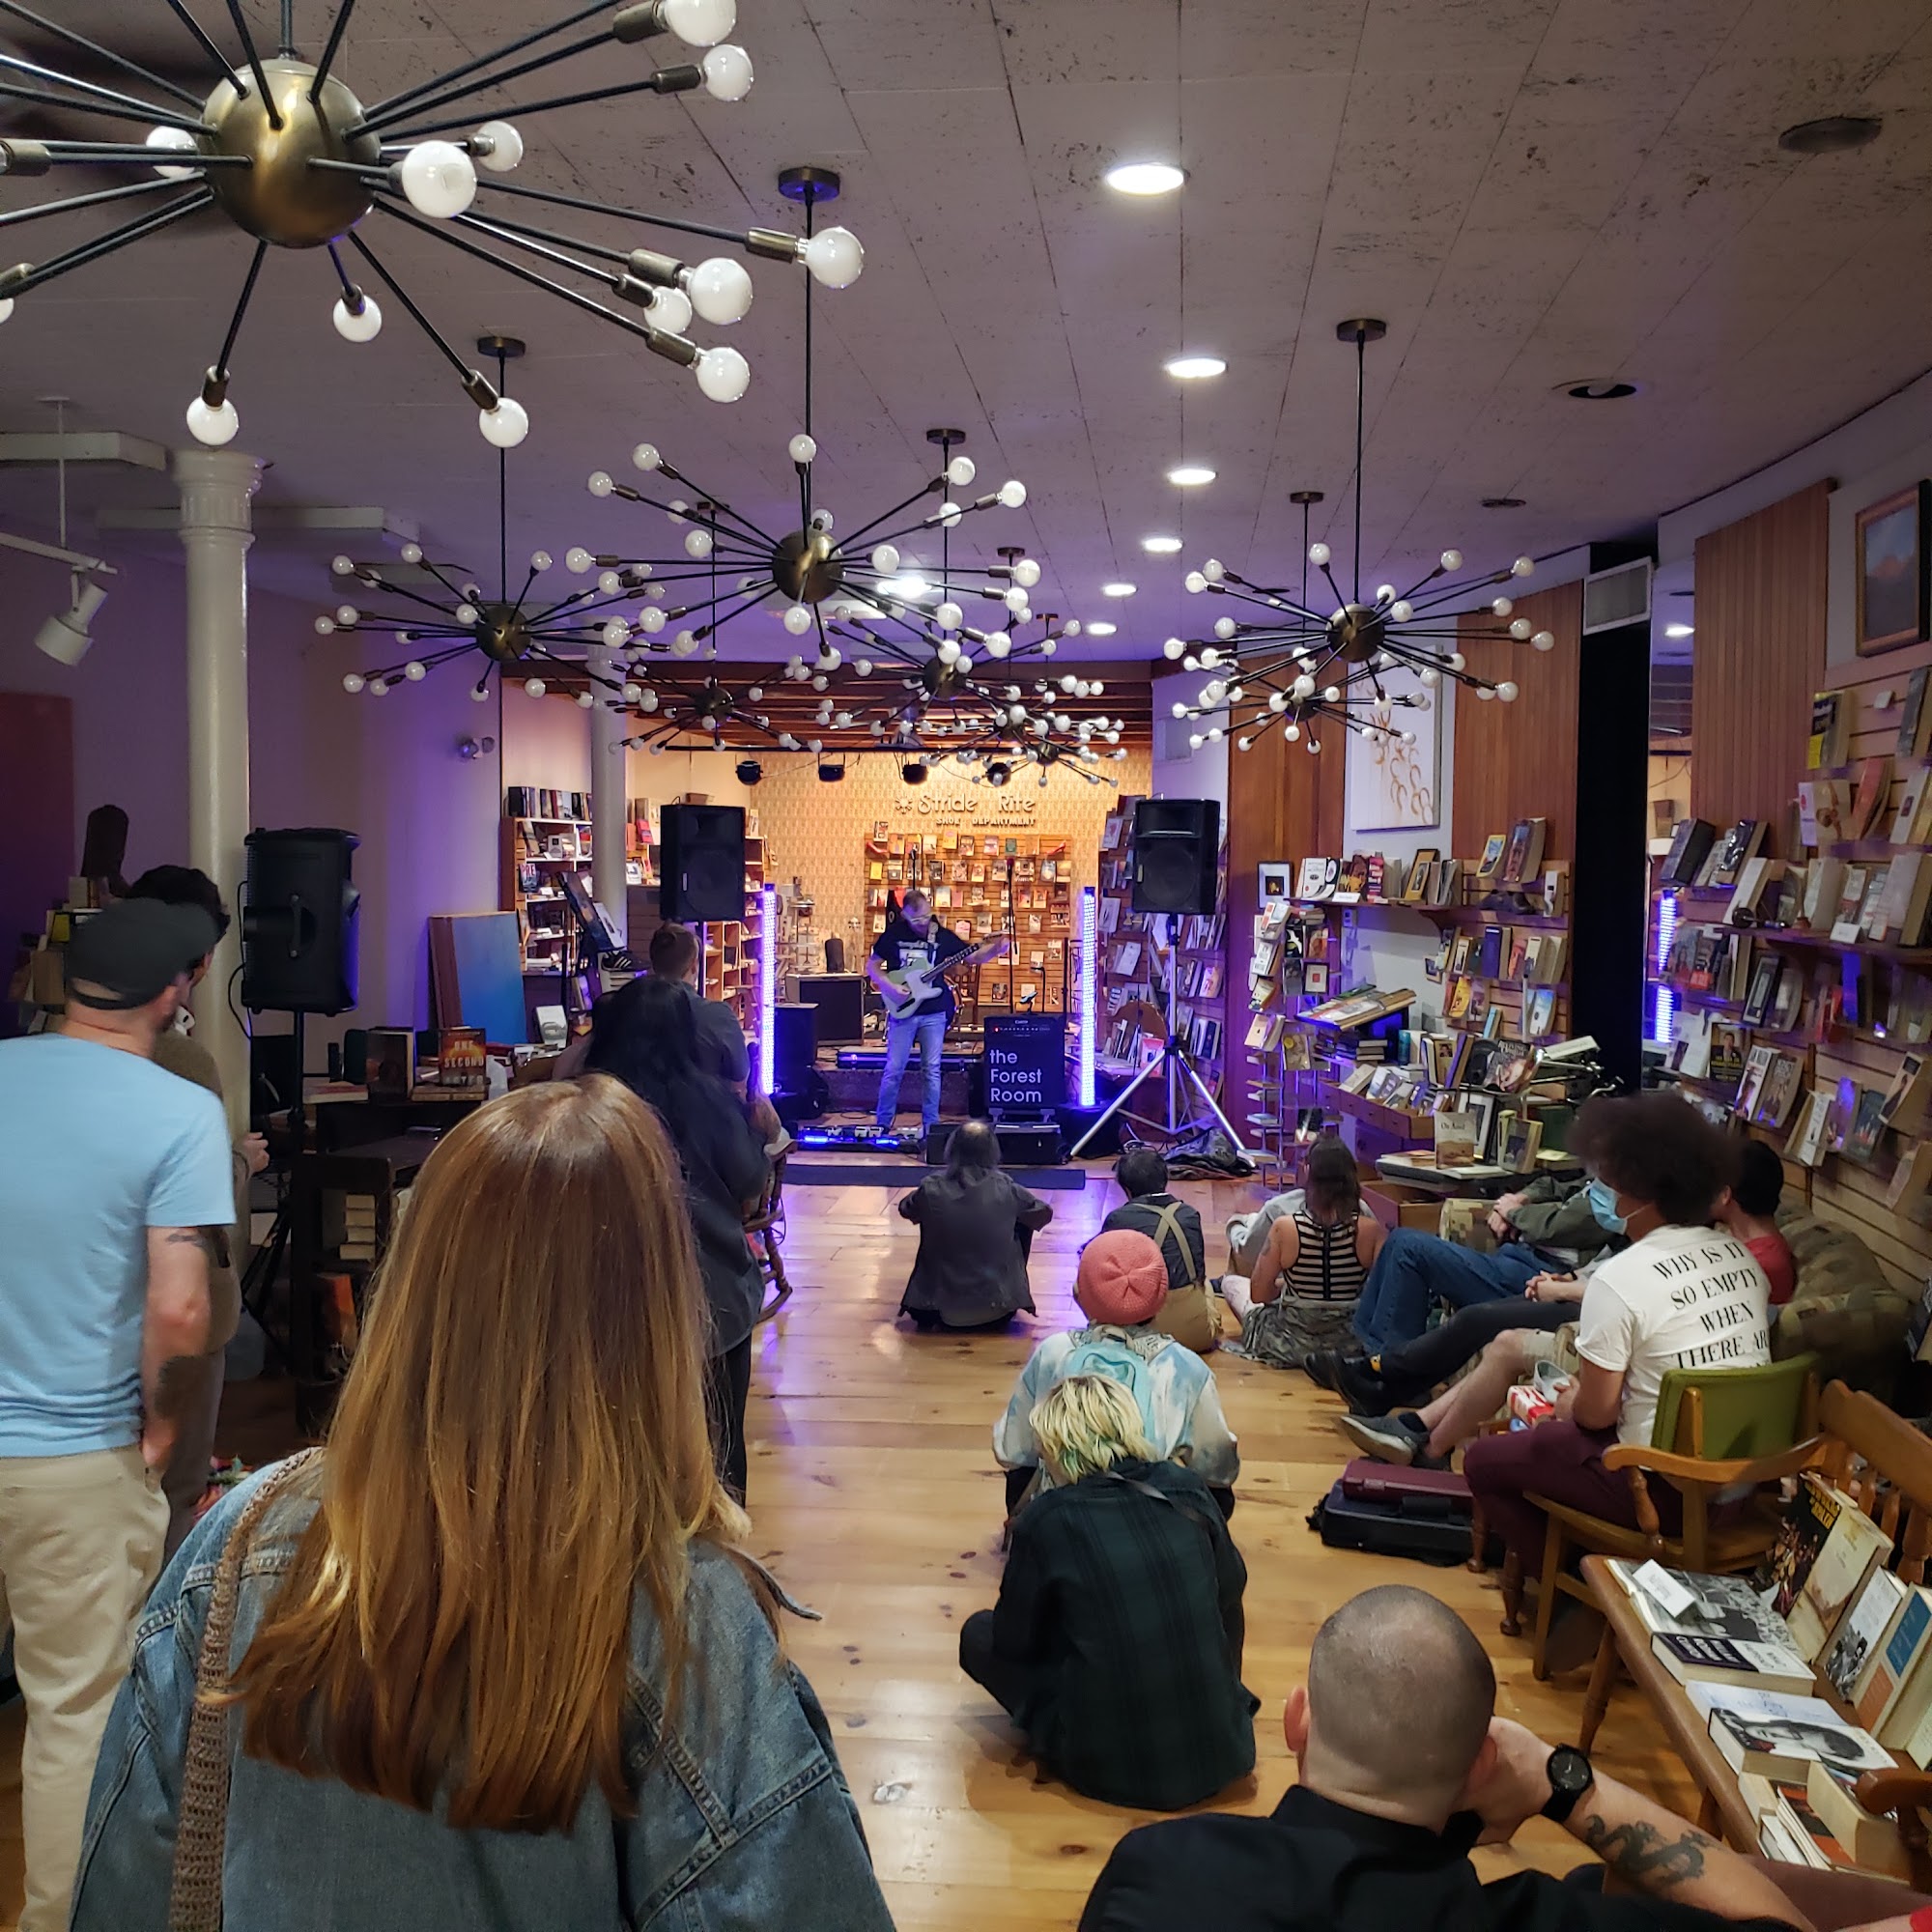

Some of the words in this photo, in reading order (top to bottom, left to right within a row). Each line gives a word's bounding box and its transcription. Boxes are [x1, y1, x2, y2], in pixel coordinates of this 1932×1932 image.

[918, 793, 978, 813] Stride
[998, 796, 1036, 813] Rite
[989, 1049, 1017, 1064] the
[990, 1068, 1042, 1083] Forest
[990, 1088, 1042, 1102] Room
[1653, 1252, 1697, 1279] WHY
[1701, 1247, 1723, 1264] IS
[1670, 1286, 1696, 1310] SO
[1700, 1268, 1757, 1298] EMPTY
[1700, 1300, 1754, 1333] WHEN
[1671, 1336, 1745, 1369] THERE
[1753, 1329, 1769, 1350] AR
